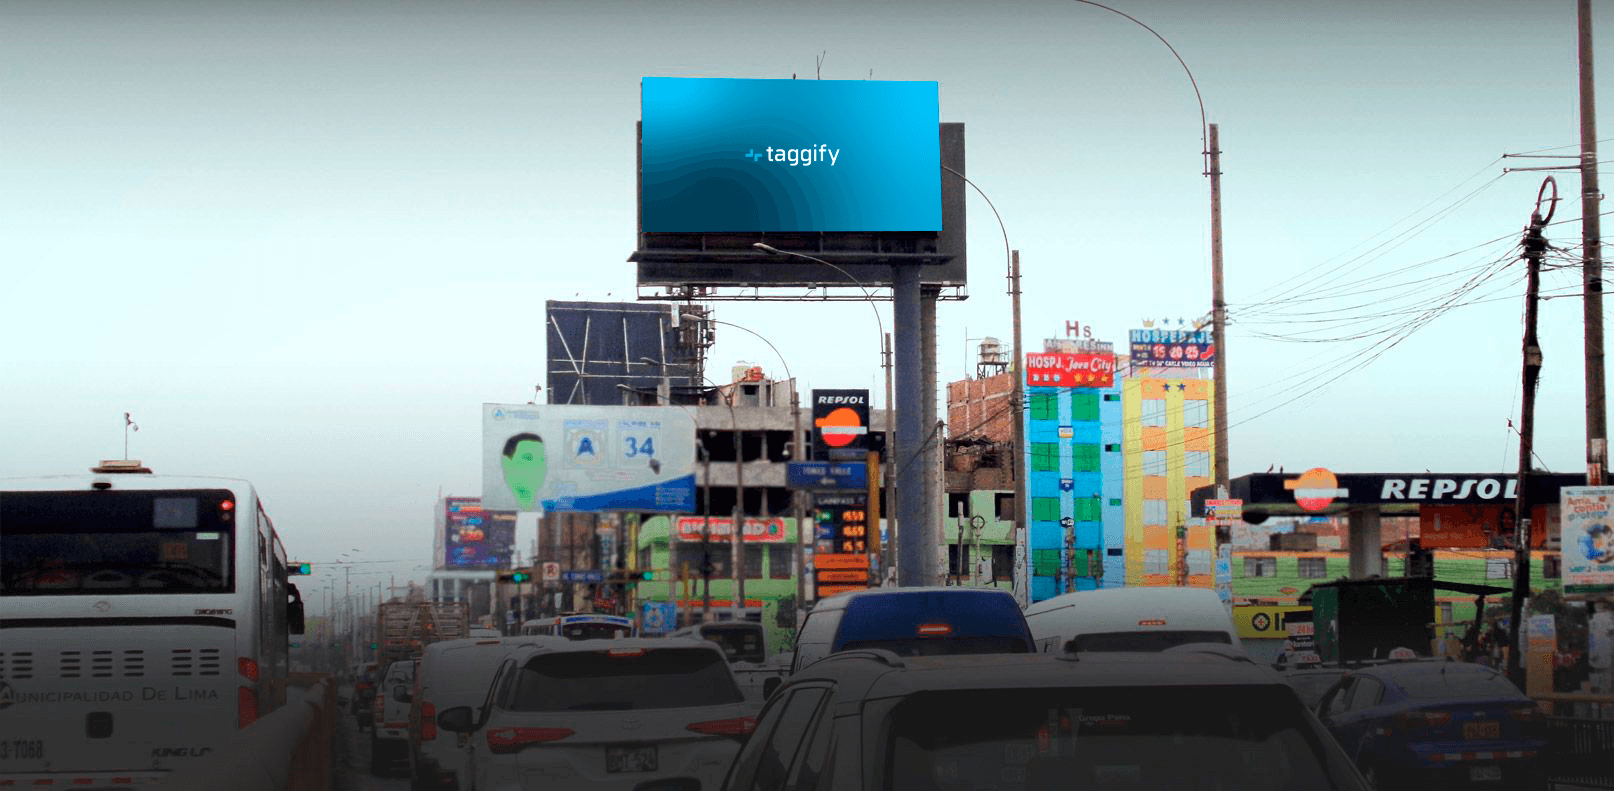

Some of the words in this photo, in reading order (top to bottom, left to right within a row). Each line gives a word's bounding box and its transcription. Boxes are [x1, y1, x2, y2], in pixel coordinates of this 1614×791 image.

[766, 144, 840, 166] taggify
[818, 396, 864, 404] REPSOL
[625, 436, 655, 458] 34
[1381, 479, 1519, 500] REPSOL
